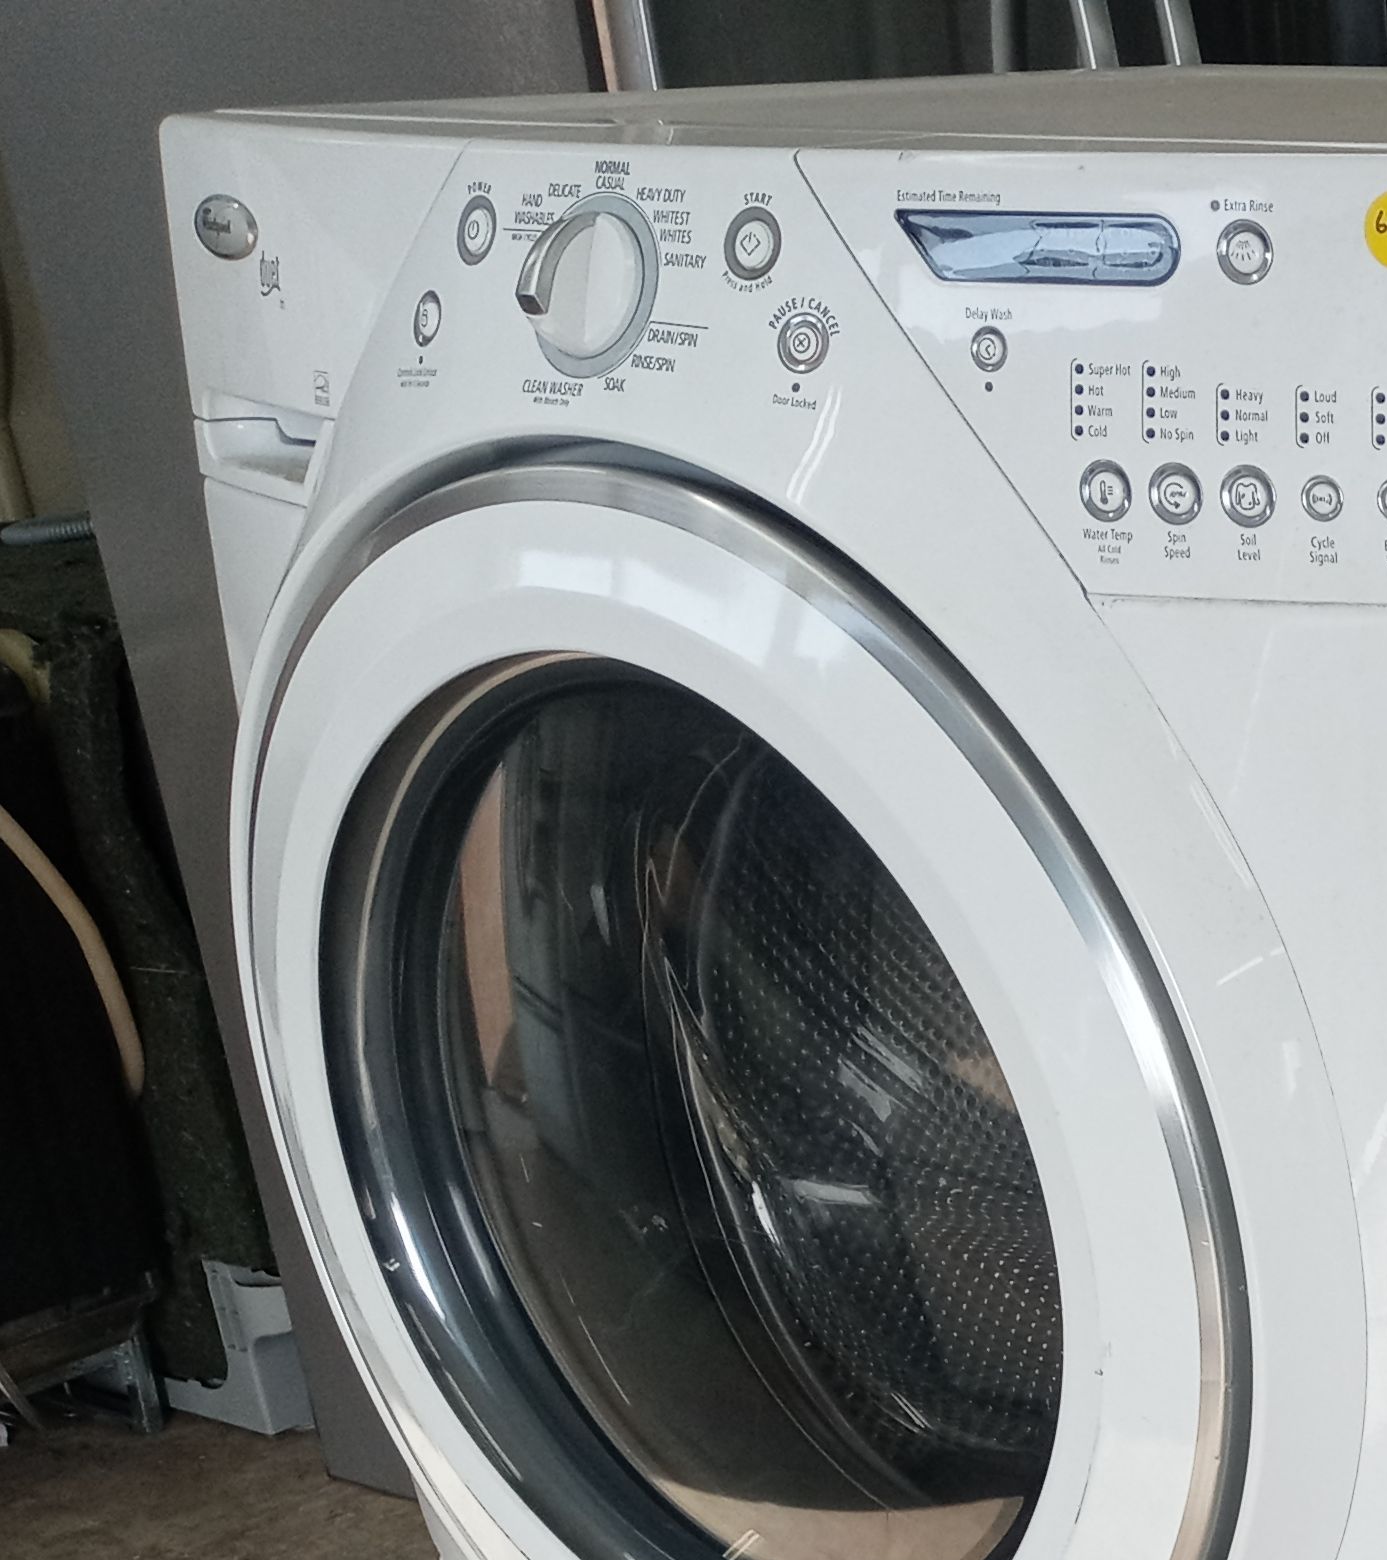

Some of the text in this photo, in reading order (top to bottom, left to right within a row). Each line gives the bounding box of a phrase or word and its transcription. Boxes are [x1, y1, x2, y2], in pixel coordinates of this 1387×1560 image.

[595, 160, 630, 175] NORMAL
[467, 181, 492, 194] POWER
[596, 175, 626, 191] CASUAL
[549, 183, 582, 199] DELICATE
[636, 187, 686, 203] HEAVY DUTY
[896, 190, 1001, 205] Estimated Time Remaining
[743, 192, 773, 207] START
[1223, 199, 1274, 212] Extra Rinse
[653, 209, 690, 225] WHITEST
[659, 229, 692, 244] WHITES
[663, 252, 706, 270] SANITARY
[722, 270, 738, 290] Press
[739, 281, 753, 293] and
[768, 296, 841, 337] PAUSE / CANCEL
[965, 307, 1012, 321] Delay Wash
[647, 328, 698, 348] DRAIN/SPIN
[631, 354, 676, 373] RINSE/SPIN
[1088, 363, 1131, 377] Super Hot
[1160, 366, 1181, 381] High
[522, 379, 584, 397] CLEAN WASHER
[603, 377, 626, 393] SOAK
[1088, 384, 1104, 396] Hot
[1160, 387, 1196, 400] Medium
[1235, 389, 1264, 405] Heavy
[1314, 390, 1337, 403] Loud
[772, 393, 817, 410] Door Locked
[1088, 405, 1113, 417] Warm
[1160, 408, 1178, 420] Low
[1235, 410, 1268, 422] Normal
[1315, 411, 1334, 424] Soft
[1088, 426, 1108, 438] Cold
[1160, 428, 1194, 443] No Spin
[1235, 431, 1258, 444] Light
[1315, 432, 1331, 445] Off
[1083, 528, 1133, 544] Water Temp
[1167, 530, 1187, 545] Spin
[1240, 533, 1257, 547] Soil
[1310, 536, 1335, 550] Cycle
[1164, 545, 1191, 560] Speed
[1237, 548, 1261, 562] Level
[1309, 551, 1339, 565] Signal
